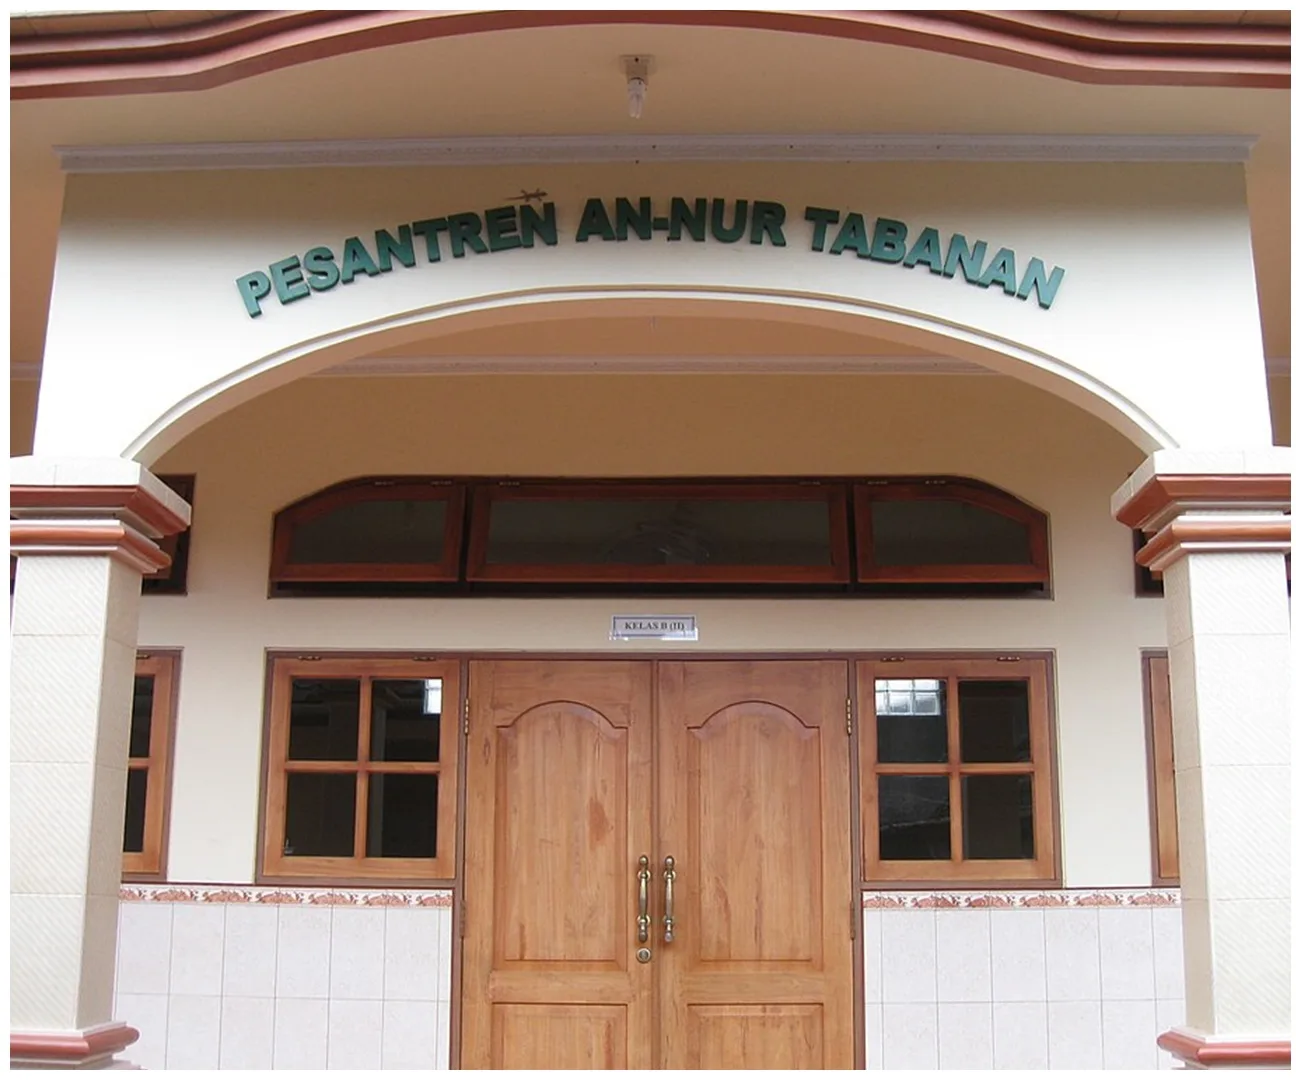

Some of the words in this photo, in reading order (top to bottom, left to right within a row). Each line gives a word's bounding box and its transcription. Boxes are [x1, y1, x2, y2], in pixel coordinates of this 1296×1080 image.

[236, 202, 558, 318] PESANTREN
[575, 197, 787, 247] AN-NUR
[804, 206, 1066, 310] TABANAN
[624, 621, 659, 630] KELAS
[660, 621, 668, 630] B
